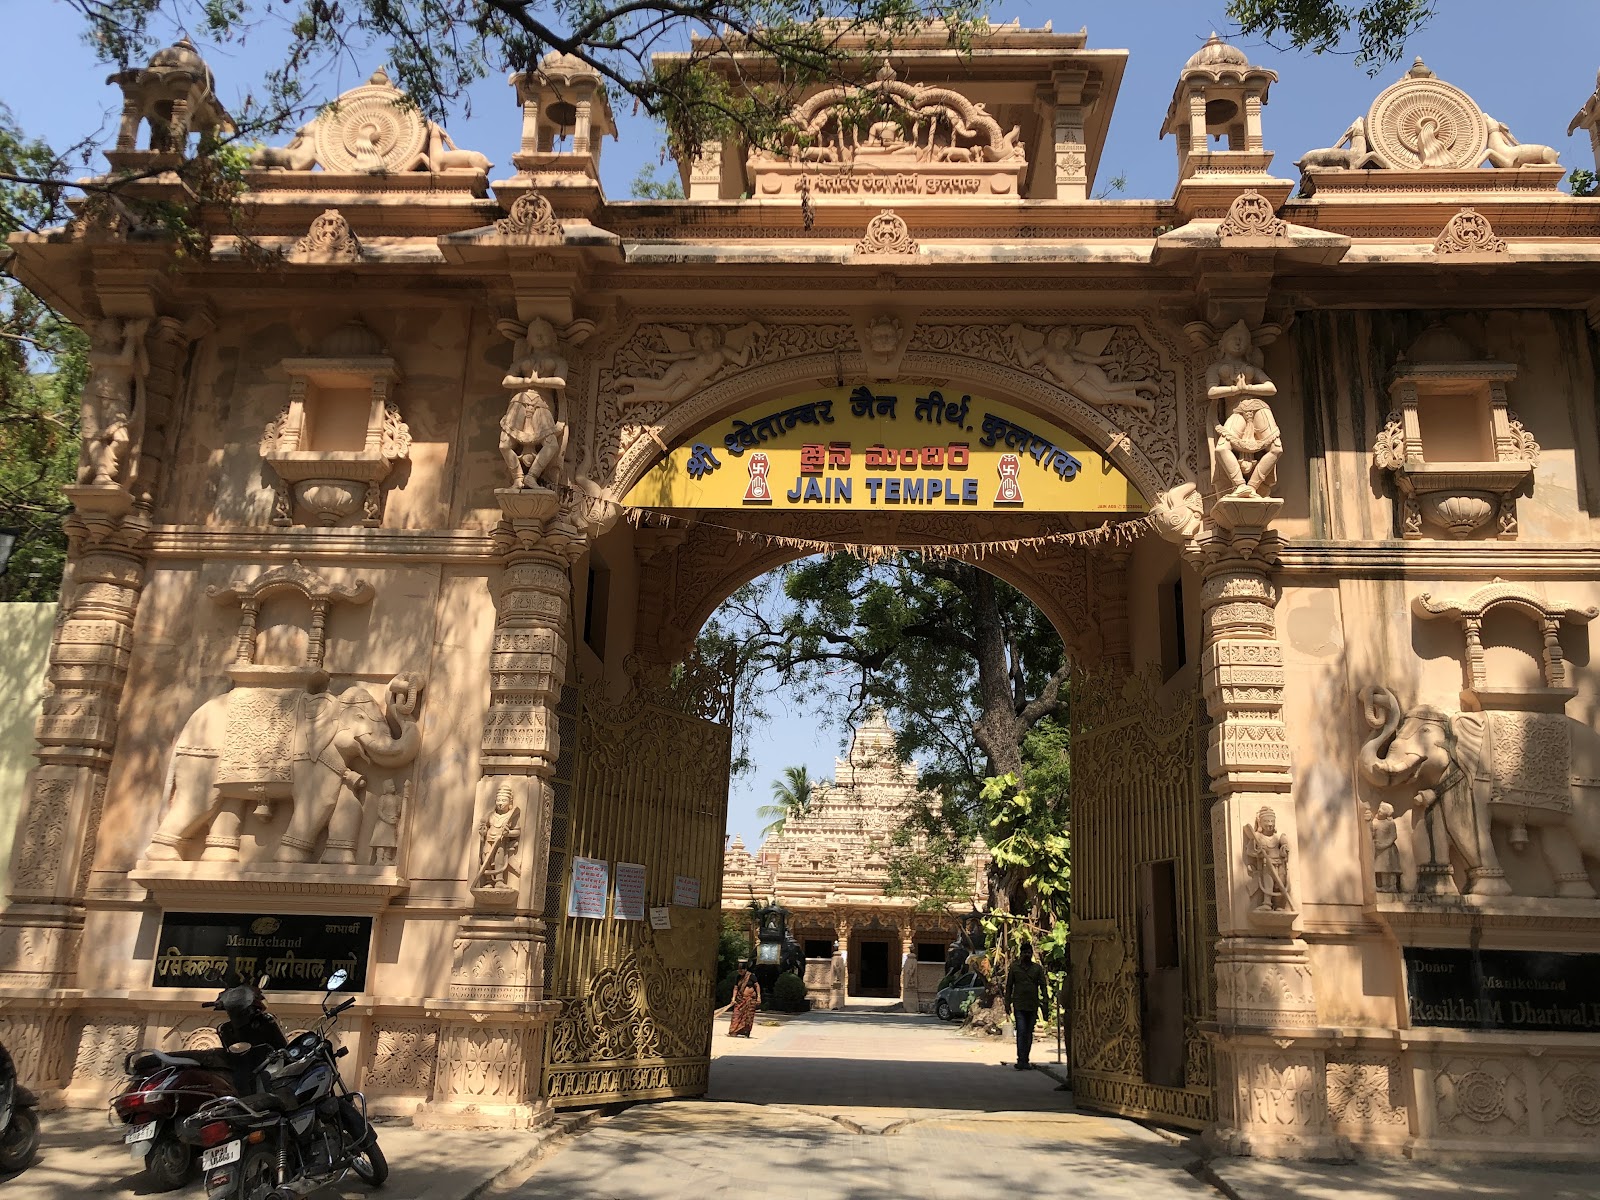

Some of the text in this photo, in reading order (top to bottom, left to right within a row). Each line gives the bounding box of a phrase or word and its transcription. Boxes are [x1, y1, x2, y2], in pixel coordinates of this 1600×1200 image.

[926, 178, 981, 194] कुलपाक
[687, 442, 721, 479] श्री
[724, 400, 835, 455] श्वेताम्बर
[849, 385, 897, 419] जैन
[979, 412, 1082, 480] कुलपाक
[801, 442, 970, 476] జైన్ మందిర్
[787, 477, 979, 504] JAIN TEMPLE
[226, 935, 302, 948] Manikchand
[1414, 960, 1455, 973] Donor
[1482, 976, 1567, 991] Manikchand
[1412, 998, 1481, 1021] Rasiklal
